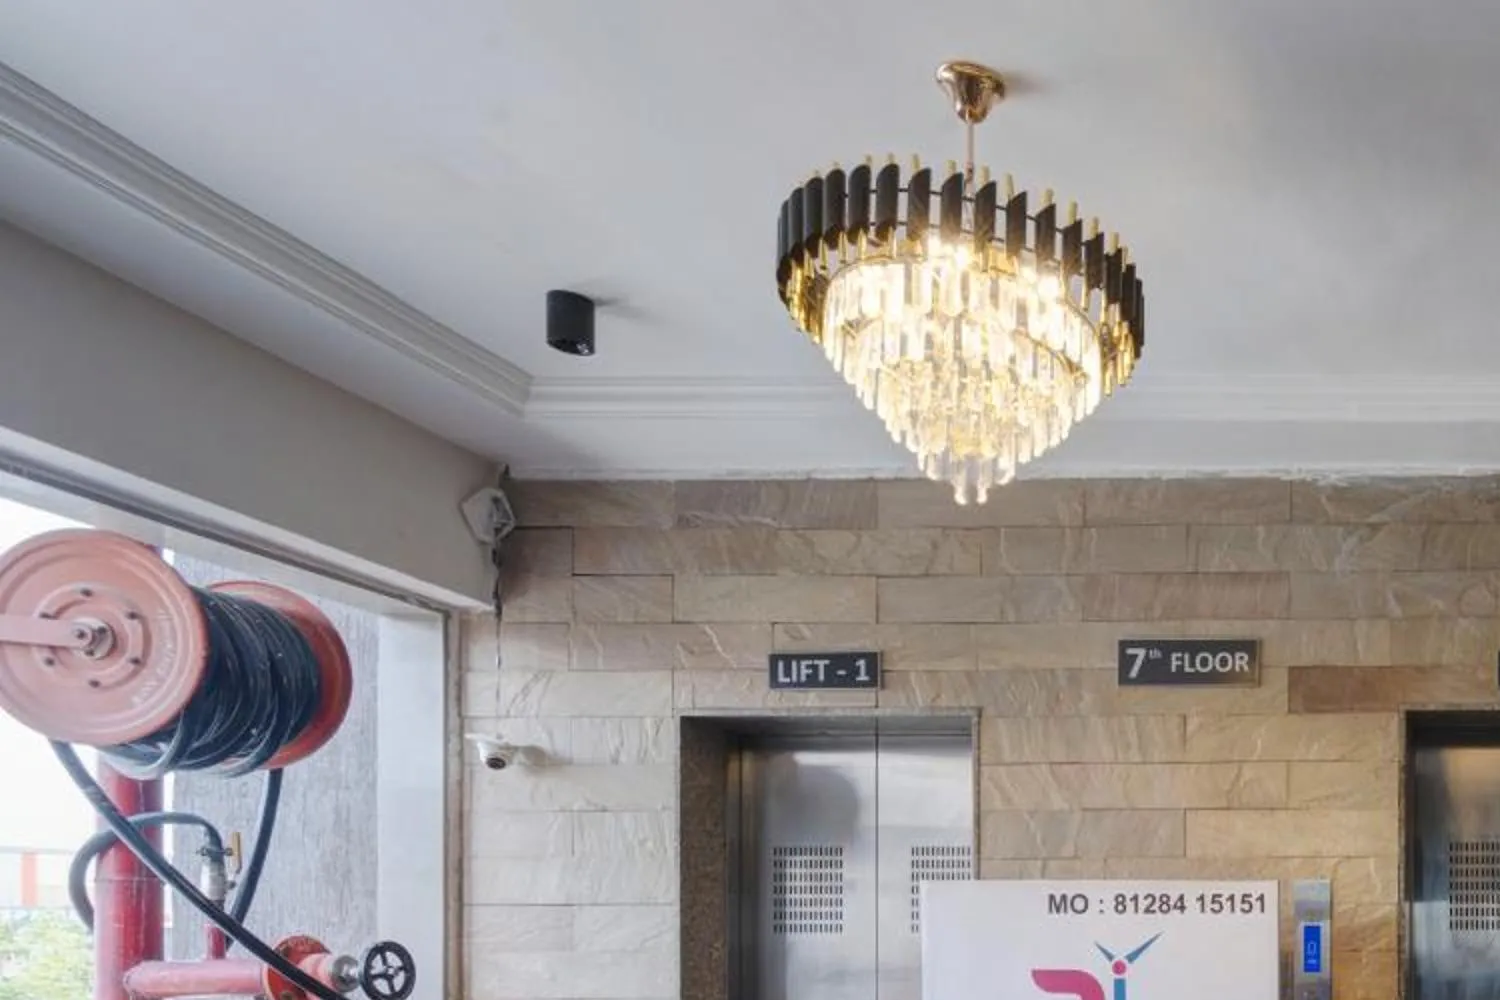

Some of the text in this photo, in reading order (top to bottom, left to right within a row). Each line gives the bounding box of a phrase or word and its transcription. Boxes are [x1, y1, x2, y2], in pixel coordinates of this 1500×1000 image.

[777, 659, 830, 683] LIFT
[855, 659, 870, 681] 1
[1125, 647, 1249, 679] 7th FLOOR
[1047, 893, 1089, 914] MO
[1113, 893, 1187, 914] 81284
[1195, 894, 1266, 914] 15151
